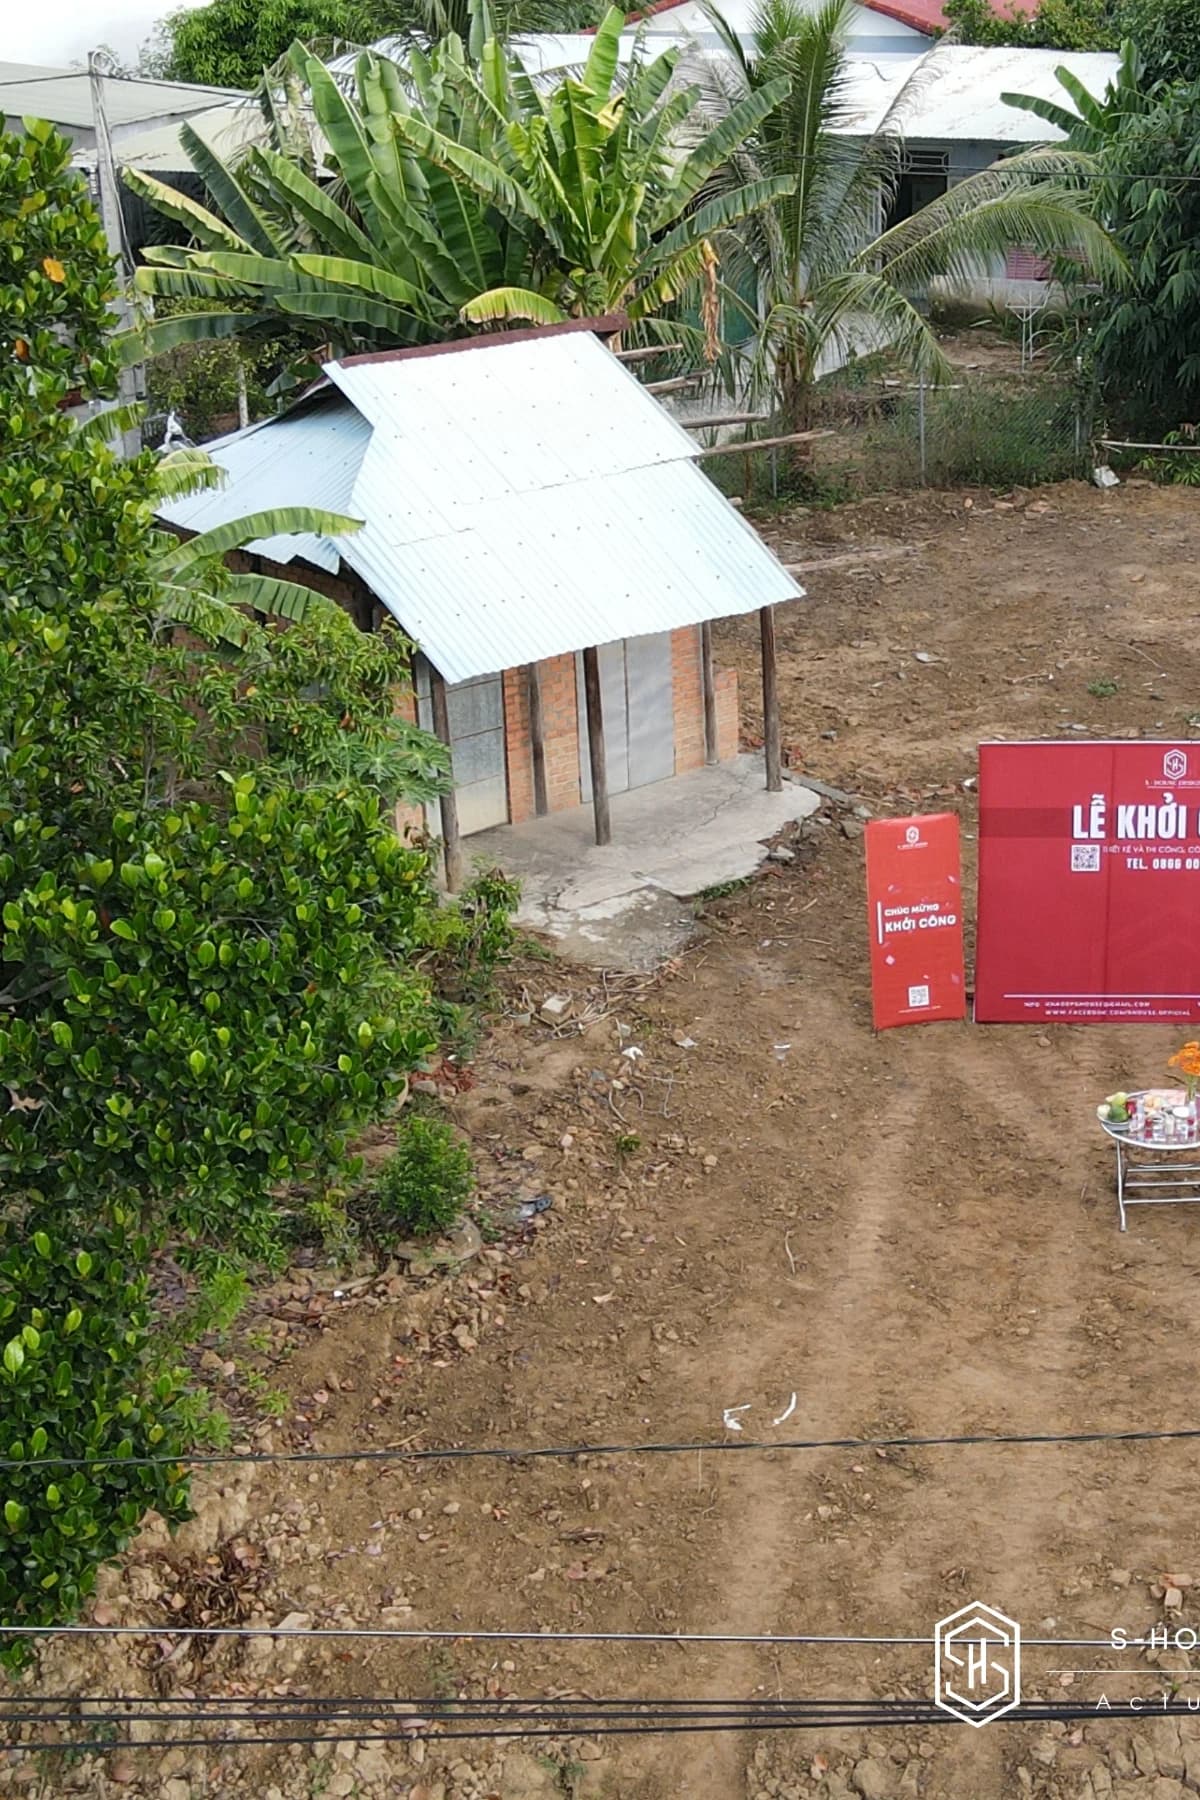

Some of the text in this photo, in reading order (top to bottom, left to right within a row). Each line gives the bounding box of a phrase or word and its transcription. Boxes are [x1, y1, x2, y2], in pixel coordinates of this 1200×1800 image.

[1072, 794, 1106, 839] LỄ
[1117, 792, 1187, 839] KHỞI
[884, 906, 909, 917] CHÚC
[884, 915, 956, 933] KHỞI CÔNG
